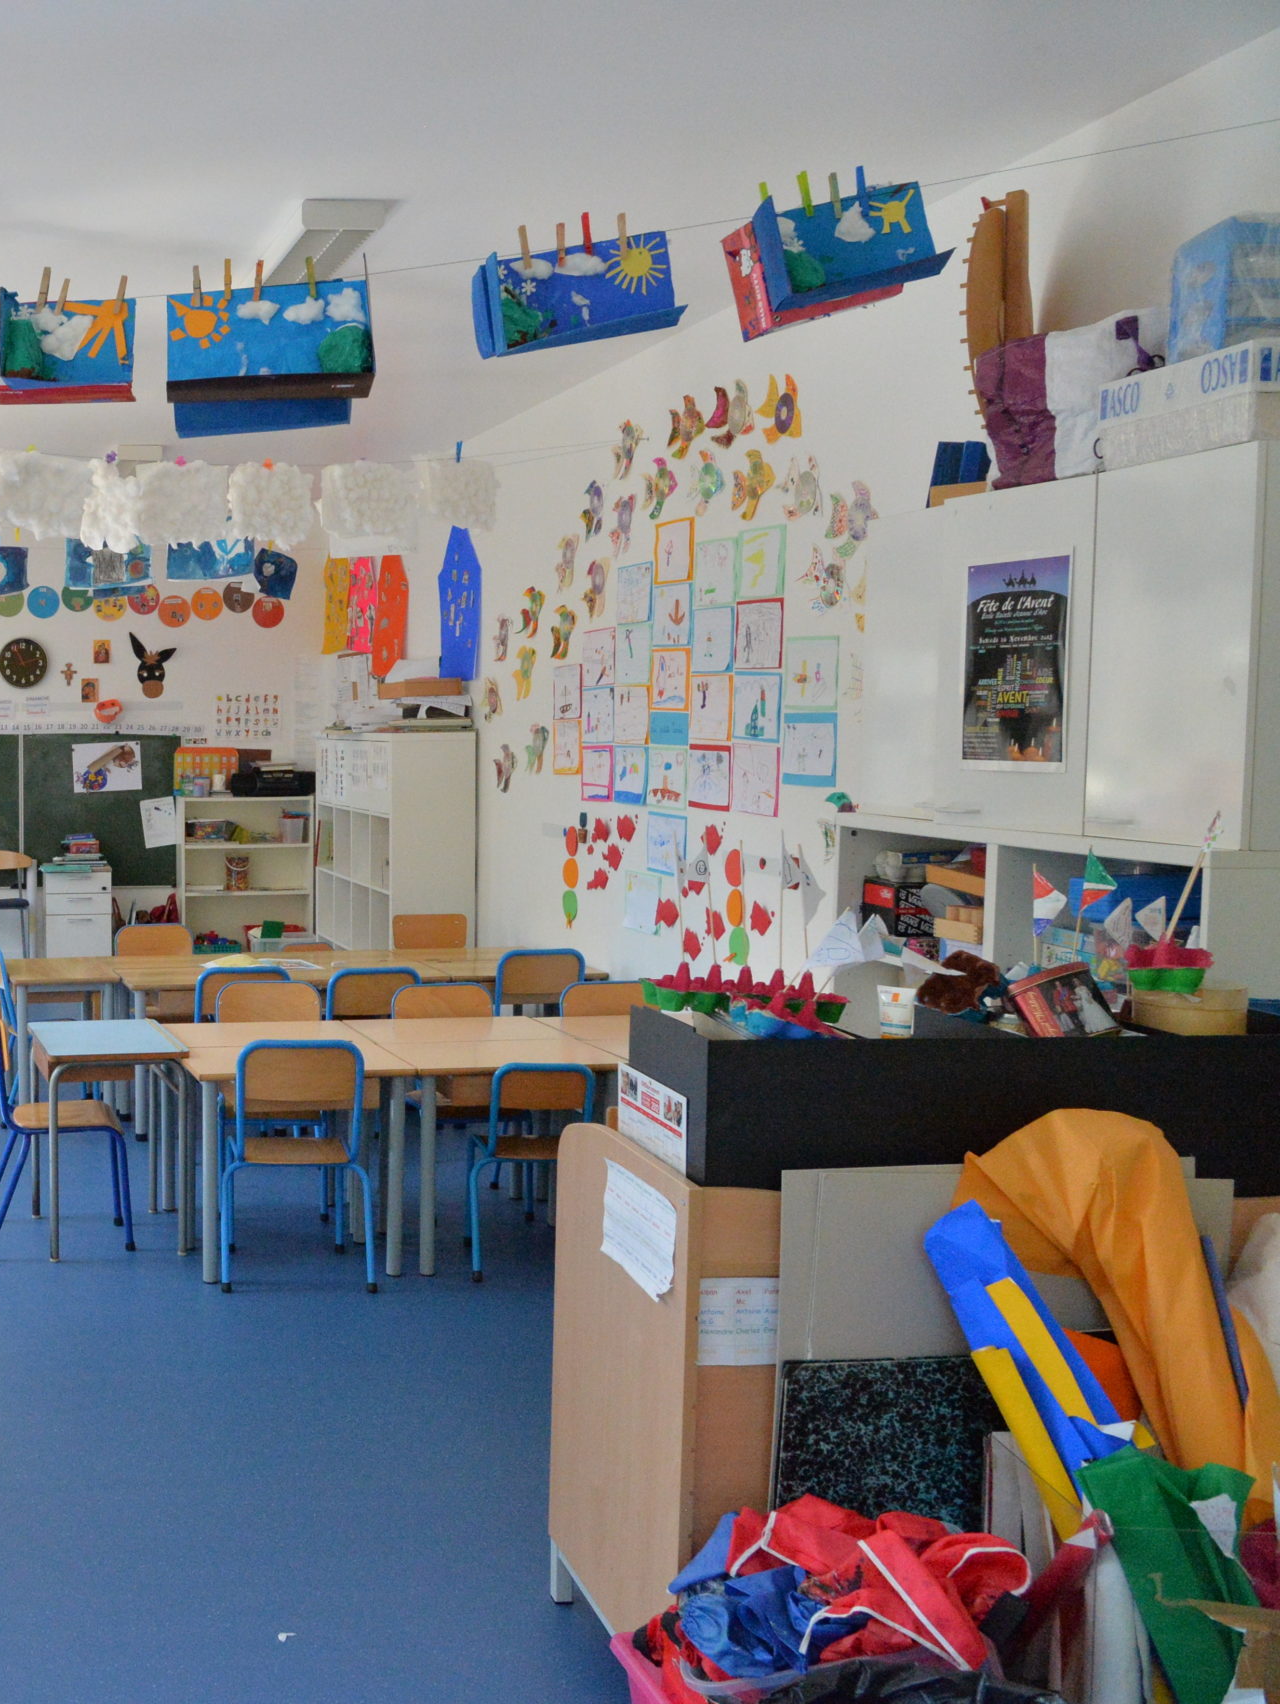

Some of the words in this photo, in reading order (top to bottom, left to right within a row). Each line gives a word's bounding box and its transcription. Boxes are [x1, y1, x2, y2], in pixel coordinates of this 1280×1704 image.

[1200, 351, 1239, 394] ASCO
[1109, 382, 1141, 418] ASCO
[977, 600, 1000, 612] Fête
[1002, 596, 1015, 610] de
[1017, 594, 1055, 610] l'Avent
[997, 691, 1028, 703] AVENT
